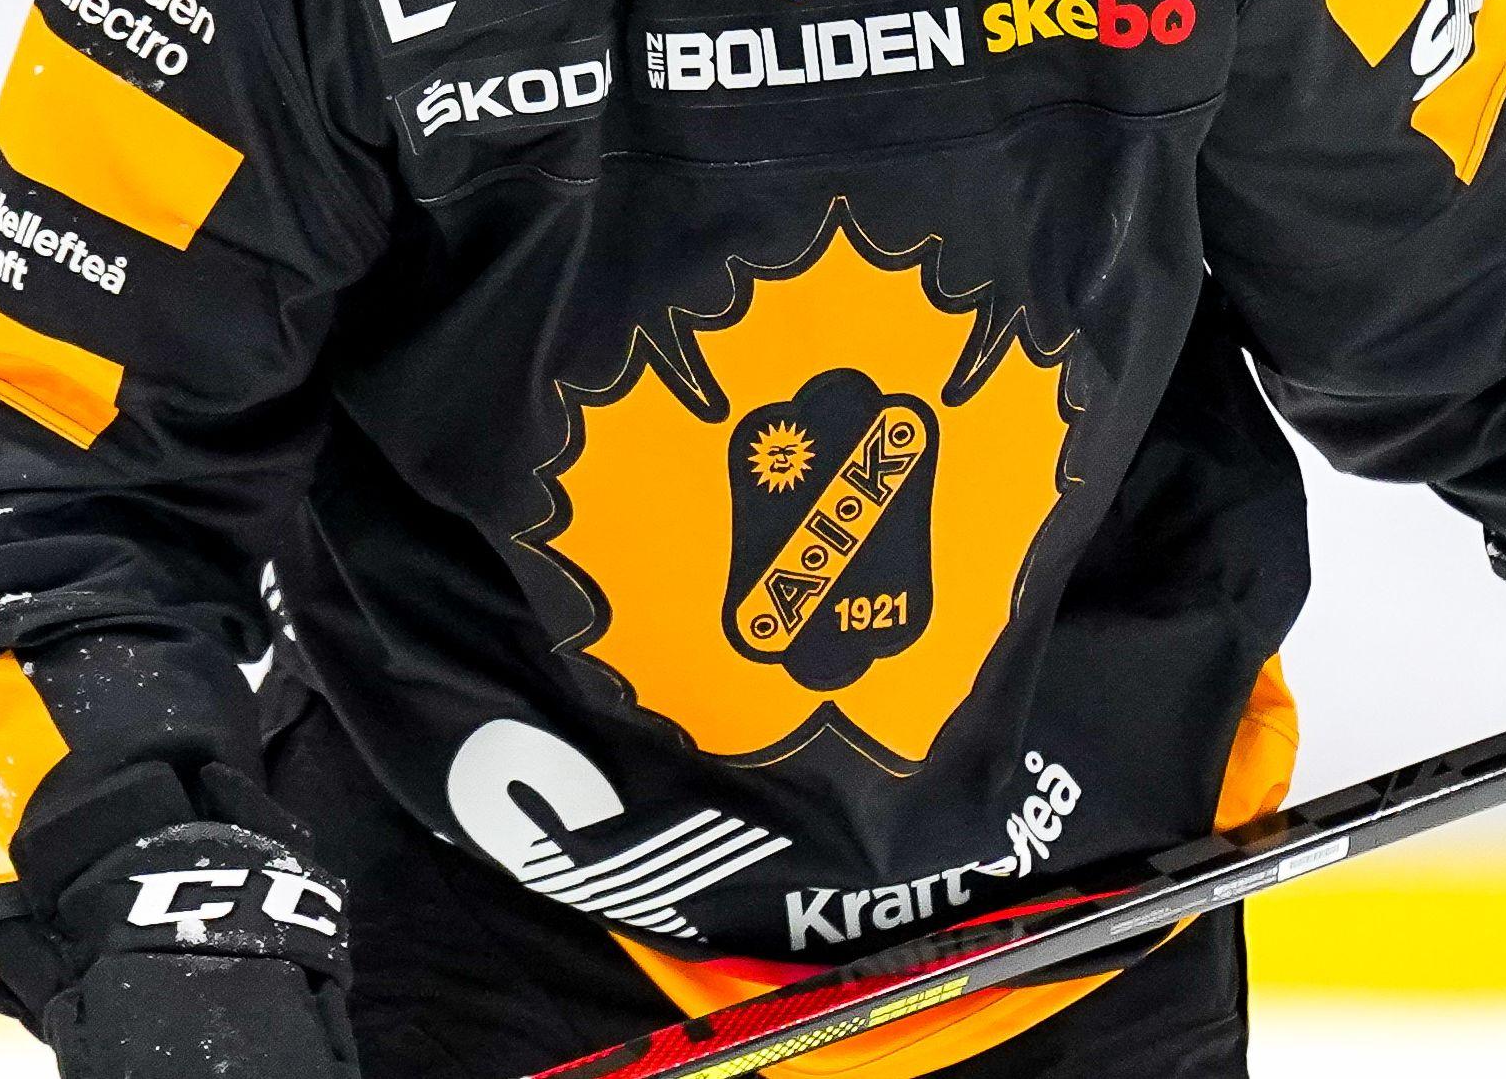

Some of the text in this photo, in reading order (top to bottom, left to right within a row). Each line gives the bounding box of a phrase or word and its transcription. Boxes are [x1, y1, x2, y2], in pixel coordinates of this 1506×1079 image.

[646, 10, 966, 91] NEW BOLIDEN
[834, 592, 908, 633] 1921
